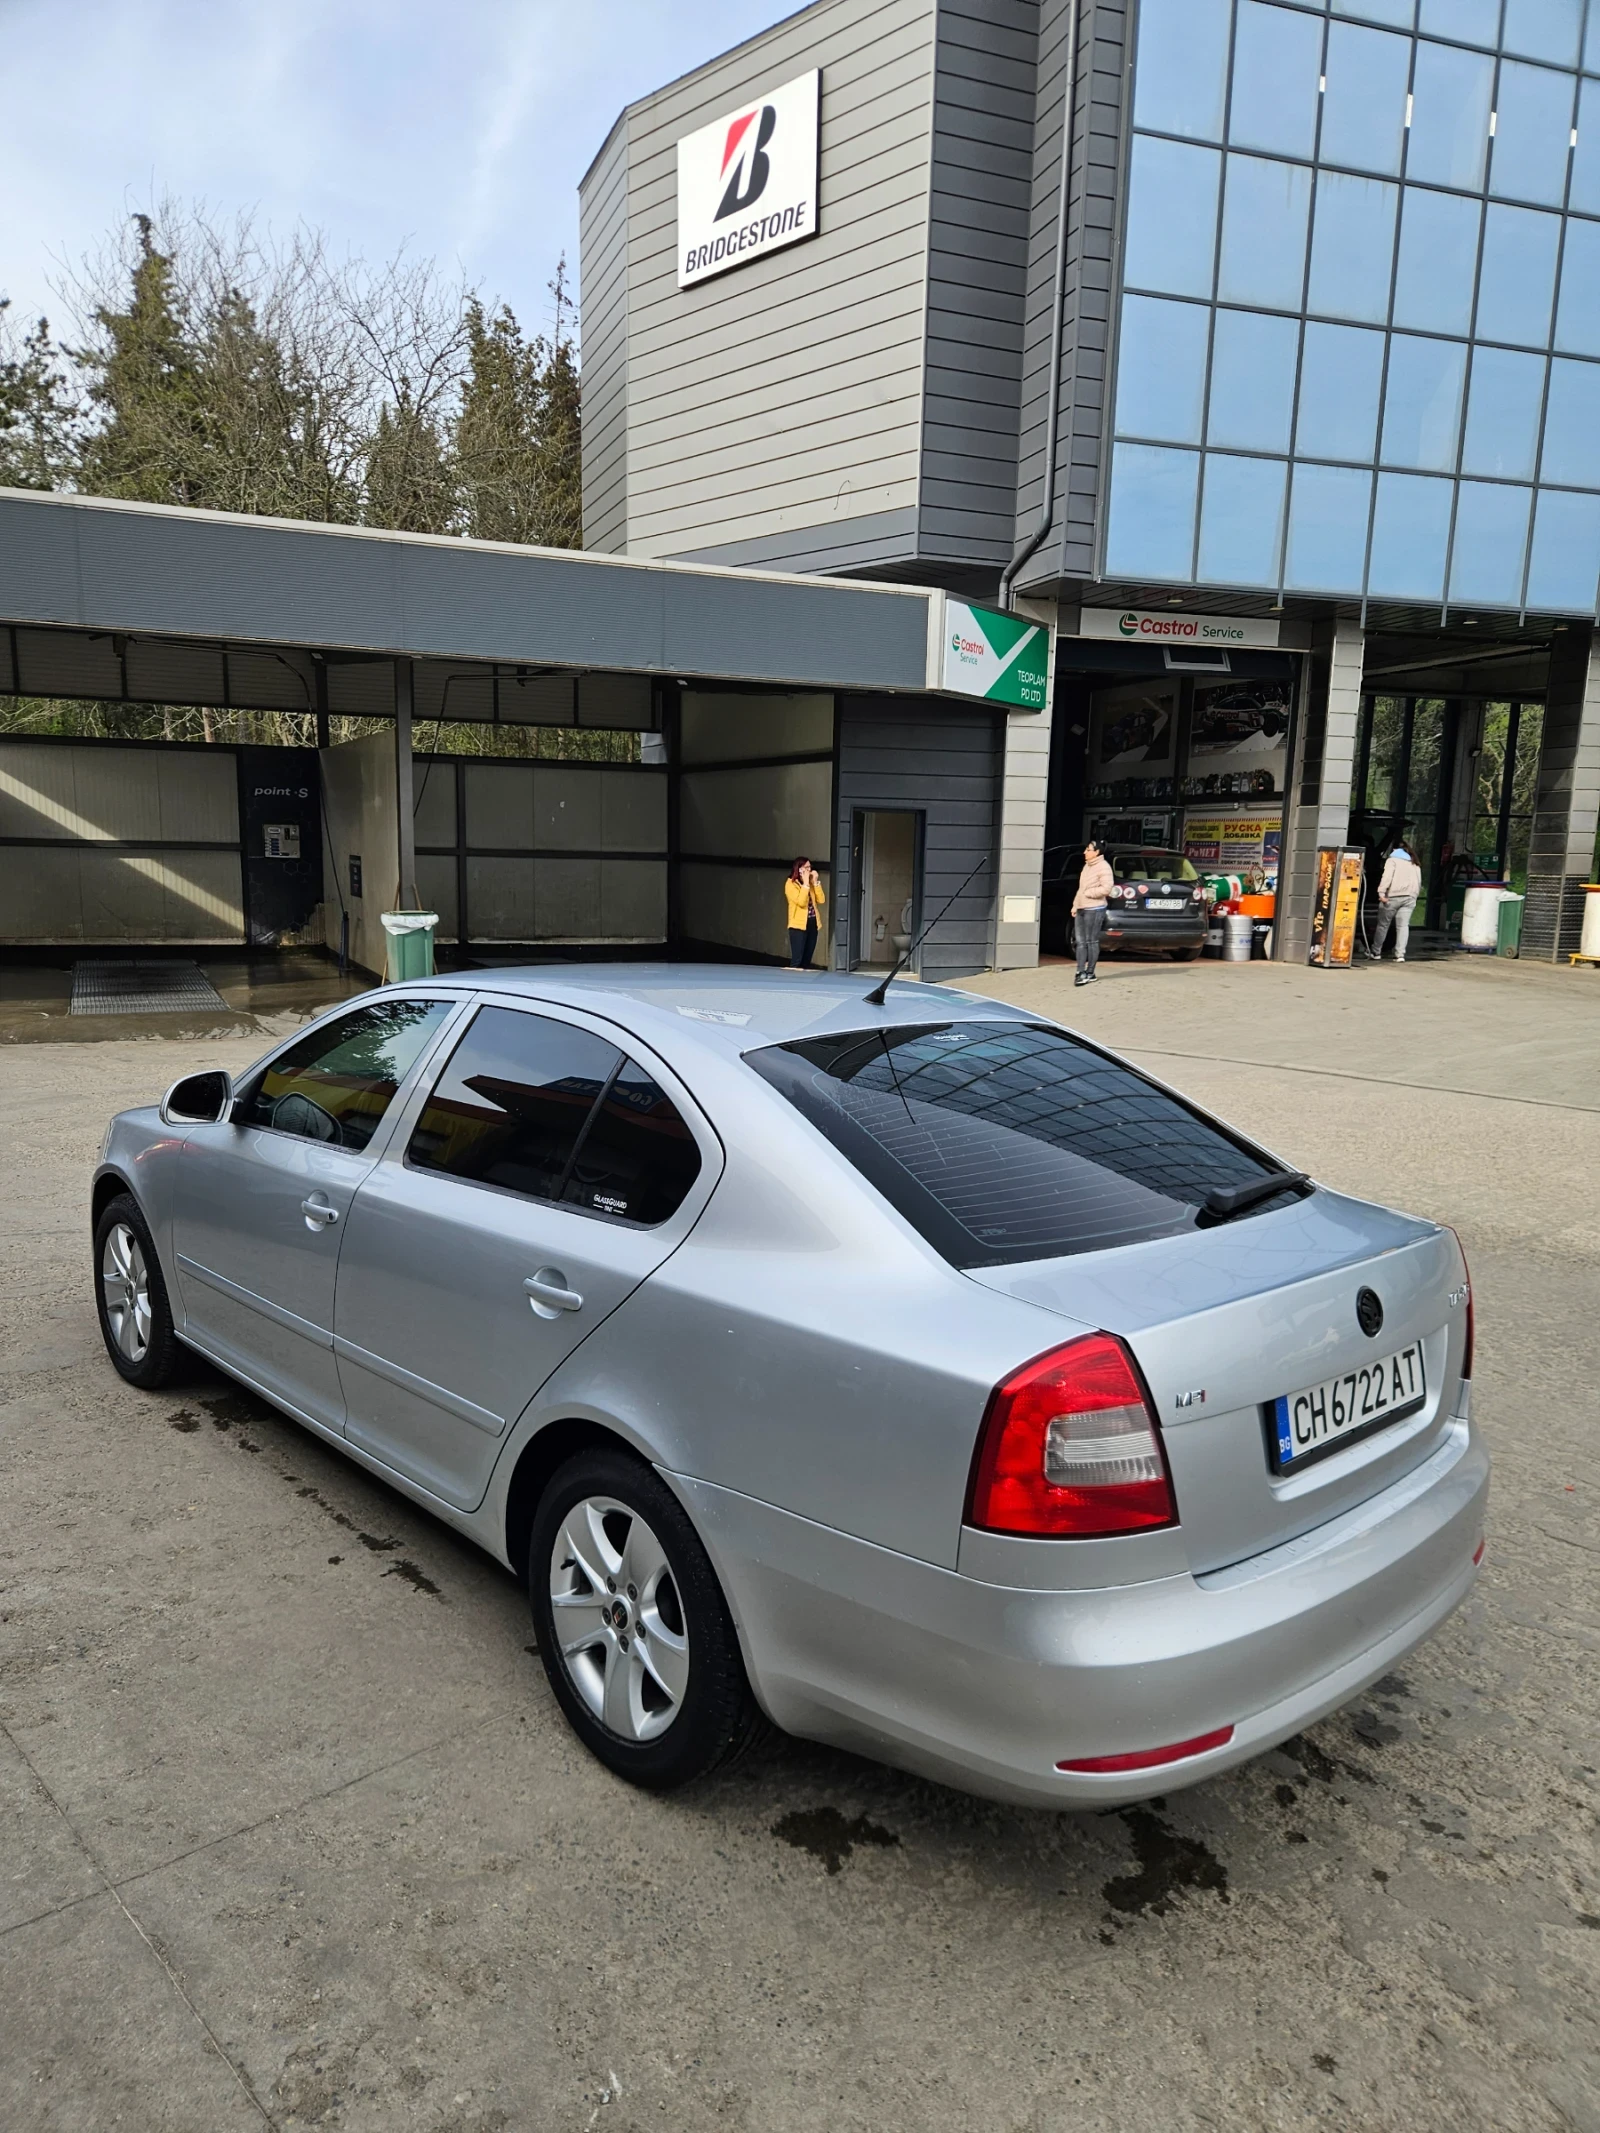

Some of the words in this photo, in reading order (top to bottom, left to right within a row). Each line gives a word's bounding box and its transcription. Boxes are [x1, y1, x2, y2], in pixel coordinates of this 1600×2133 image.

[685, 201, 807, 274] BRIDGESTONE
[1140, 617, 1198, 636] Castrol
[1202, 625, 1244, 639] Service
[961, 639, 985, 655] Castrol
[960, 652, 978, 665] Service
[1018, 670, 1046, 687] TEOPLAM
[1021, 688, 1030, 700] PD
[1031, 690, 1041, 702] LTD
[254, 786, 291, 796] point
[1224, 824, 1262, 832] РУСКА
[1322, 863, 1334, 909] ПАРФЮМ
[1279, 1436, 1291, 1453] BG
